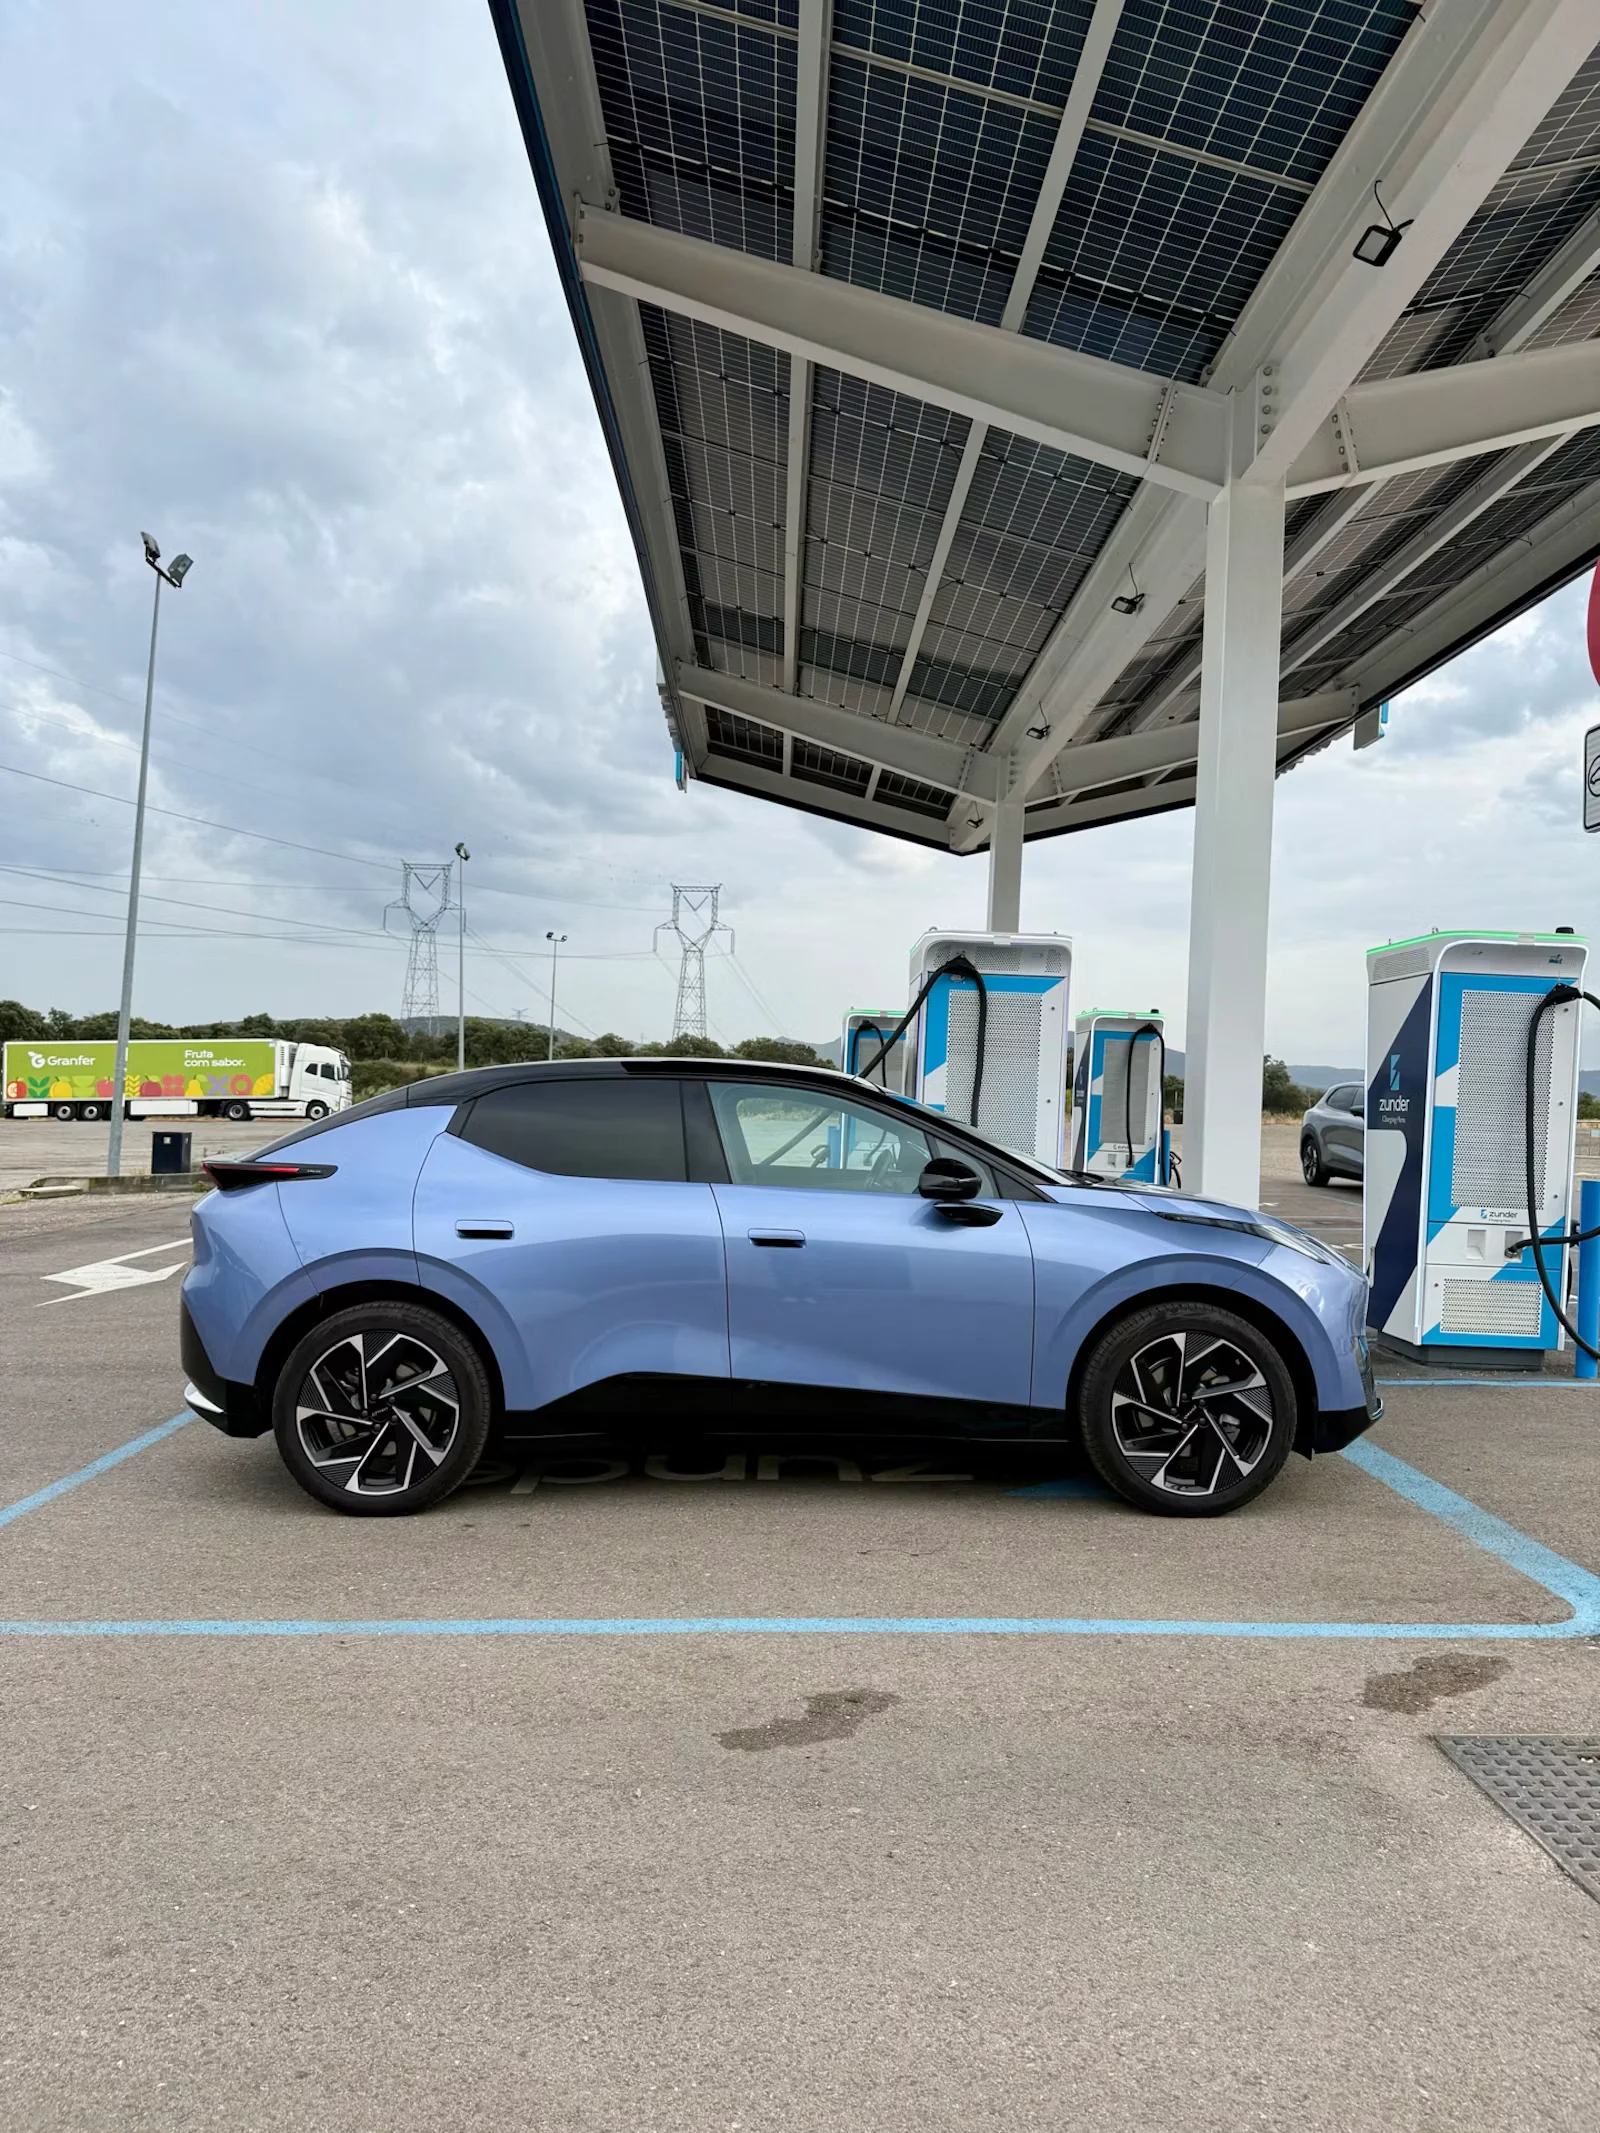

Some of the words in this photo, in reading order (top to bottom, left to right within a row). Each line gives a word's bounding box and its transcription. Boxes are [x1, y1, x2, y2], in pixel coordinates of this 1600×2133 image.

[184, 1049, 214, 1059] Fruta
[46, 1054, 96, 1066] Granfer
[184, 1059, 210, 1067] com
[211, 1057, 247, 1067] sabor.
[1379, 1095, 1410, 1112] zunder
[1489, 1211, 1518, 1219] zunder
